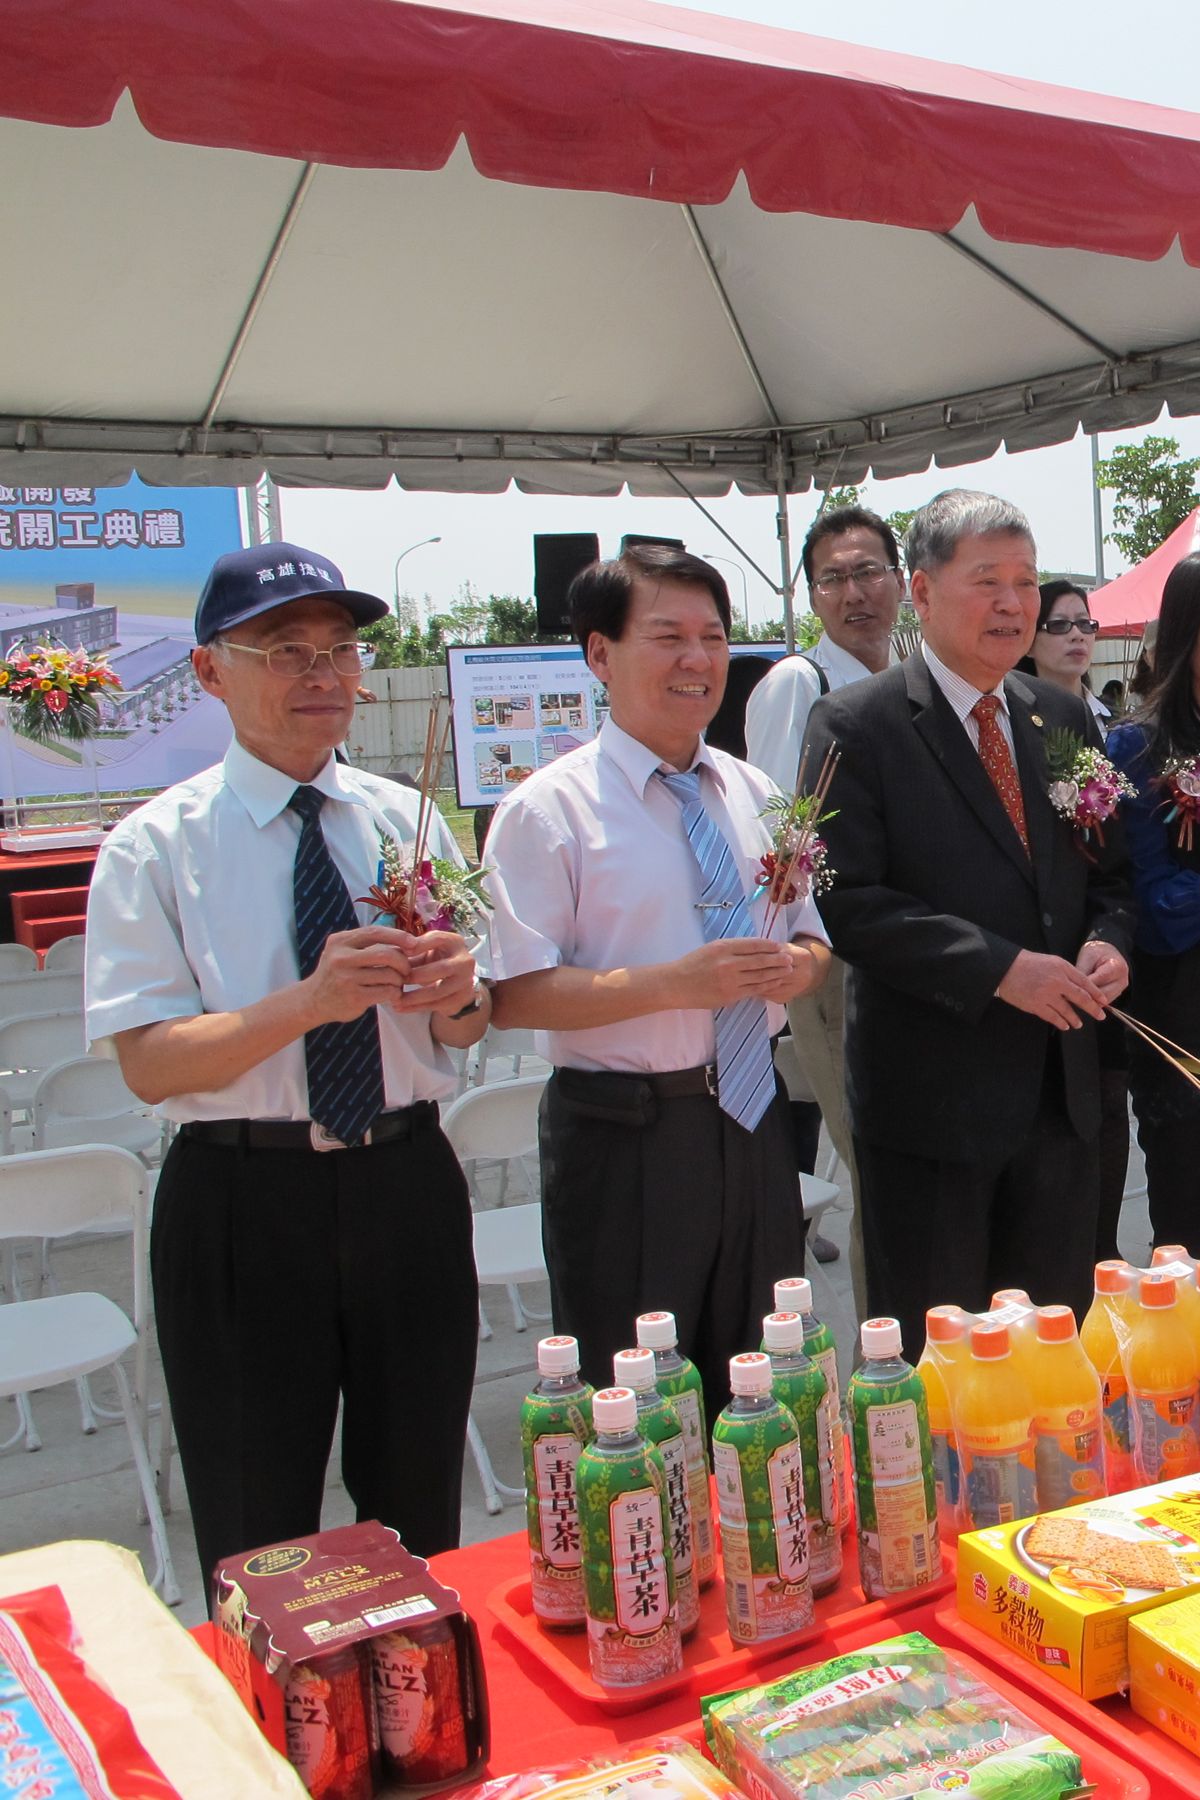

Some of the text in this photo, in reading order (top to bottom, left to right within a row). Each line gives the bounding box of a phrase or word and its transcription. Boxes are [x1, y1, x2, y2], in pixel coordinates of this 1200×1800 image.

[256, 562, 333, 585] 高雄捷運
[545, 1459, 580, 1552] 青草茶
[666, 1461, 691, 1560] 青草茶
[781, 1466, 808, 1568] 青草茶
[624, 1516, 661, 1618] 青草茶
[991, 1585, 1045, 1642] 多穀物
